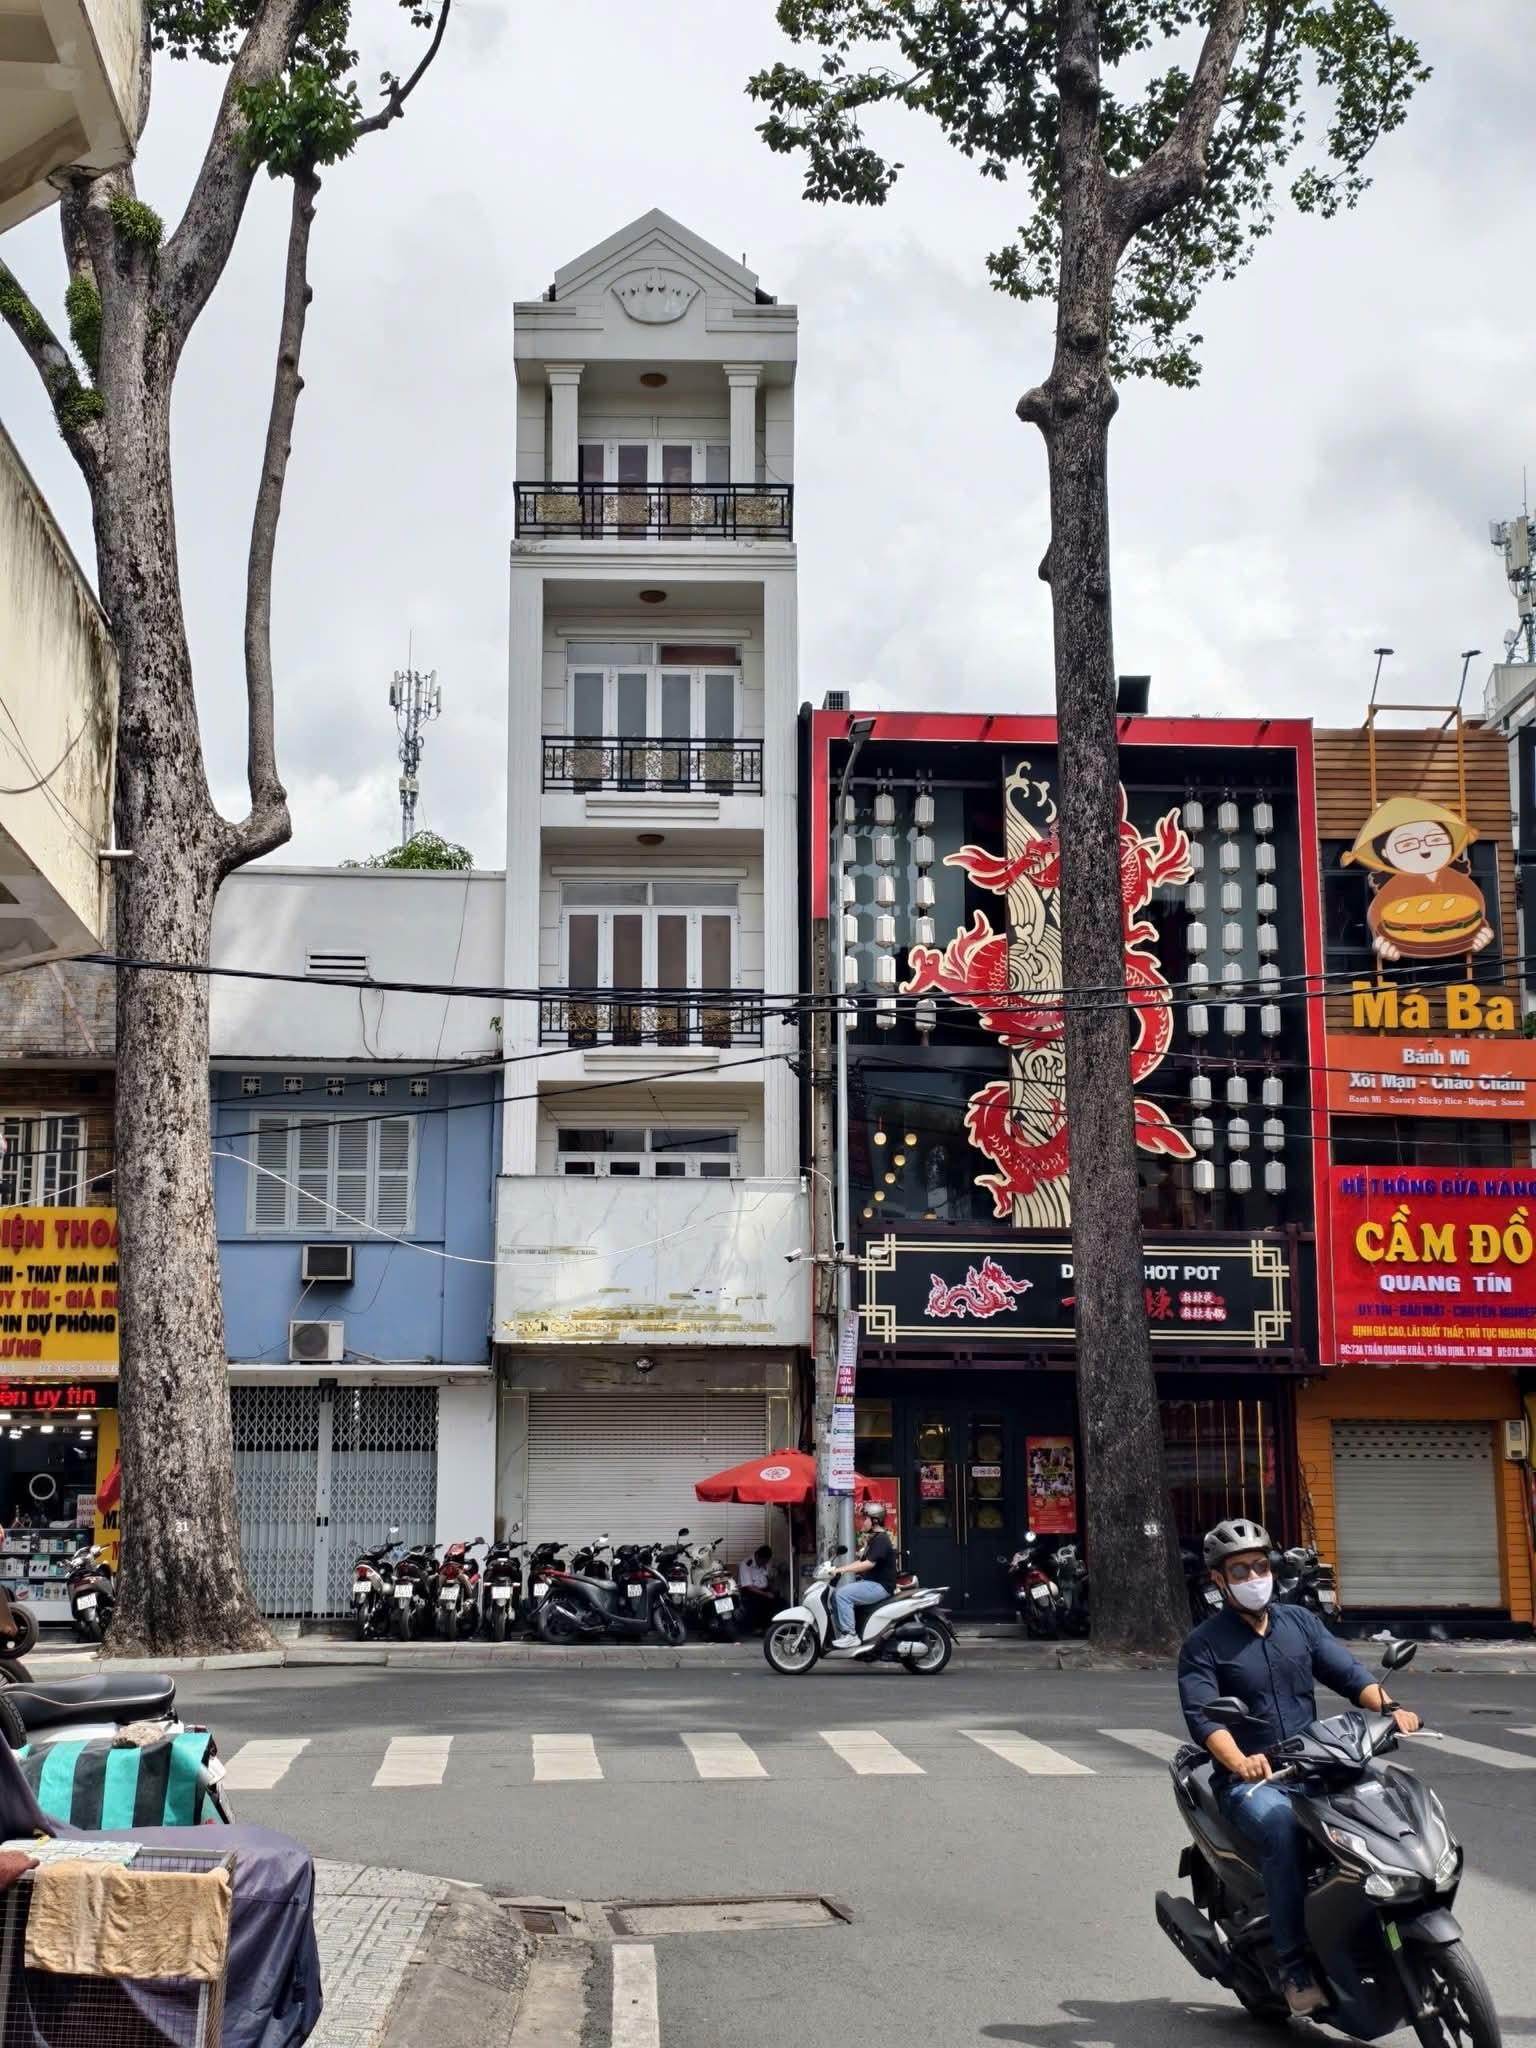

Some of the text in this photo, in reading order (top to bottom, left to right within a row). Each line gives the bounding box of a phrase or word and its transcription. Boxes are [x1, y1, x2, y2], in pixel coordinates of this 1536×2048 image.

[1352, 981, 1515, 1030] Má Ba
[1403, 1048, 1444, 1065] Bánh
[1349, 1072, 1375, 1088] Xôi
[1389, 1096, 1415, 1105] Savory
[1418, 1096, 1443, 1106] Sticky
[1445, 1097, 1462, 1105] Rice
[1356, 1204, 1533, 1264] CẦM ĐỒ
[27, 1265, 61, 1283] THAY
[66, 1261, 99, 1283] MÀN
[1144, 1265, 1220, 1280] HOT POT
[1380, 1272, 1512, 1293] QUANG TÍN
[21, 1286, 50, 1309] TÍN
[55, 1311, 116, 1333] PHÒNG
[34, 1390, 61, 1410] uy
